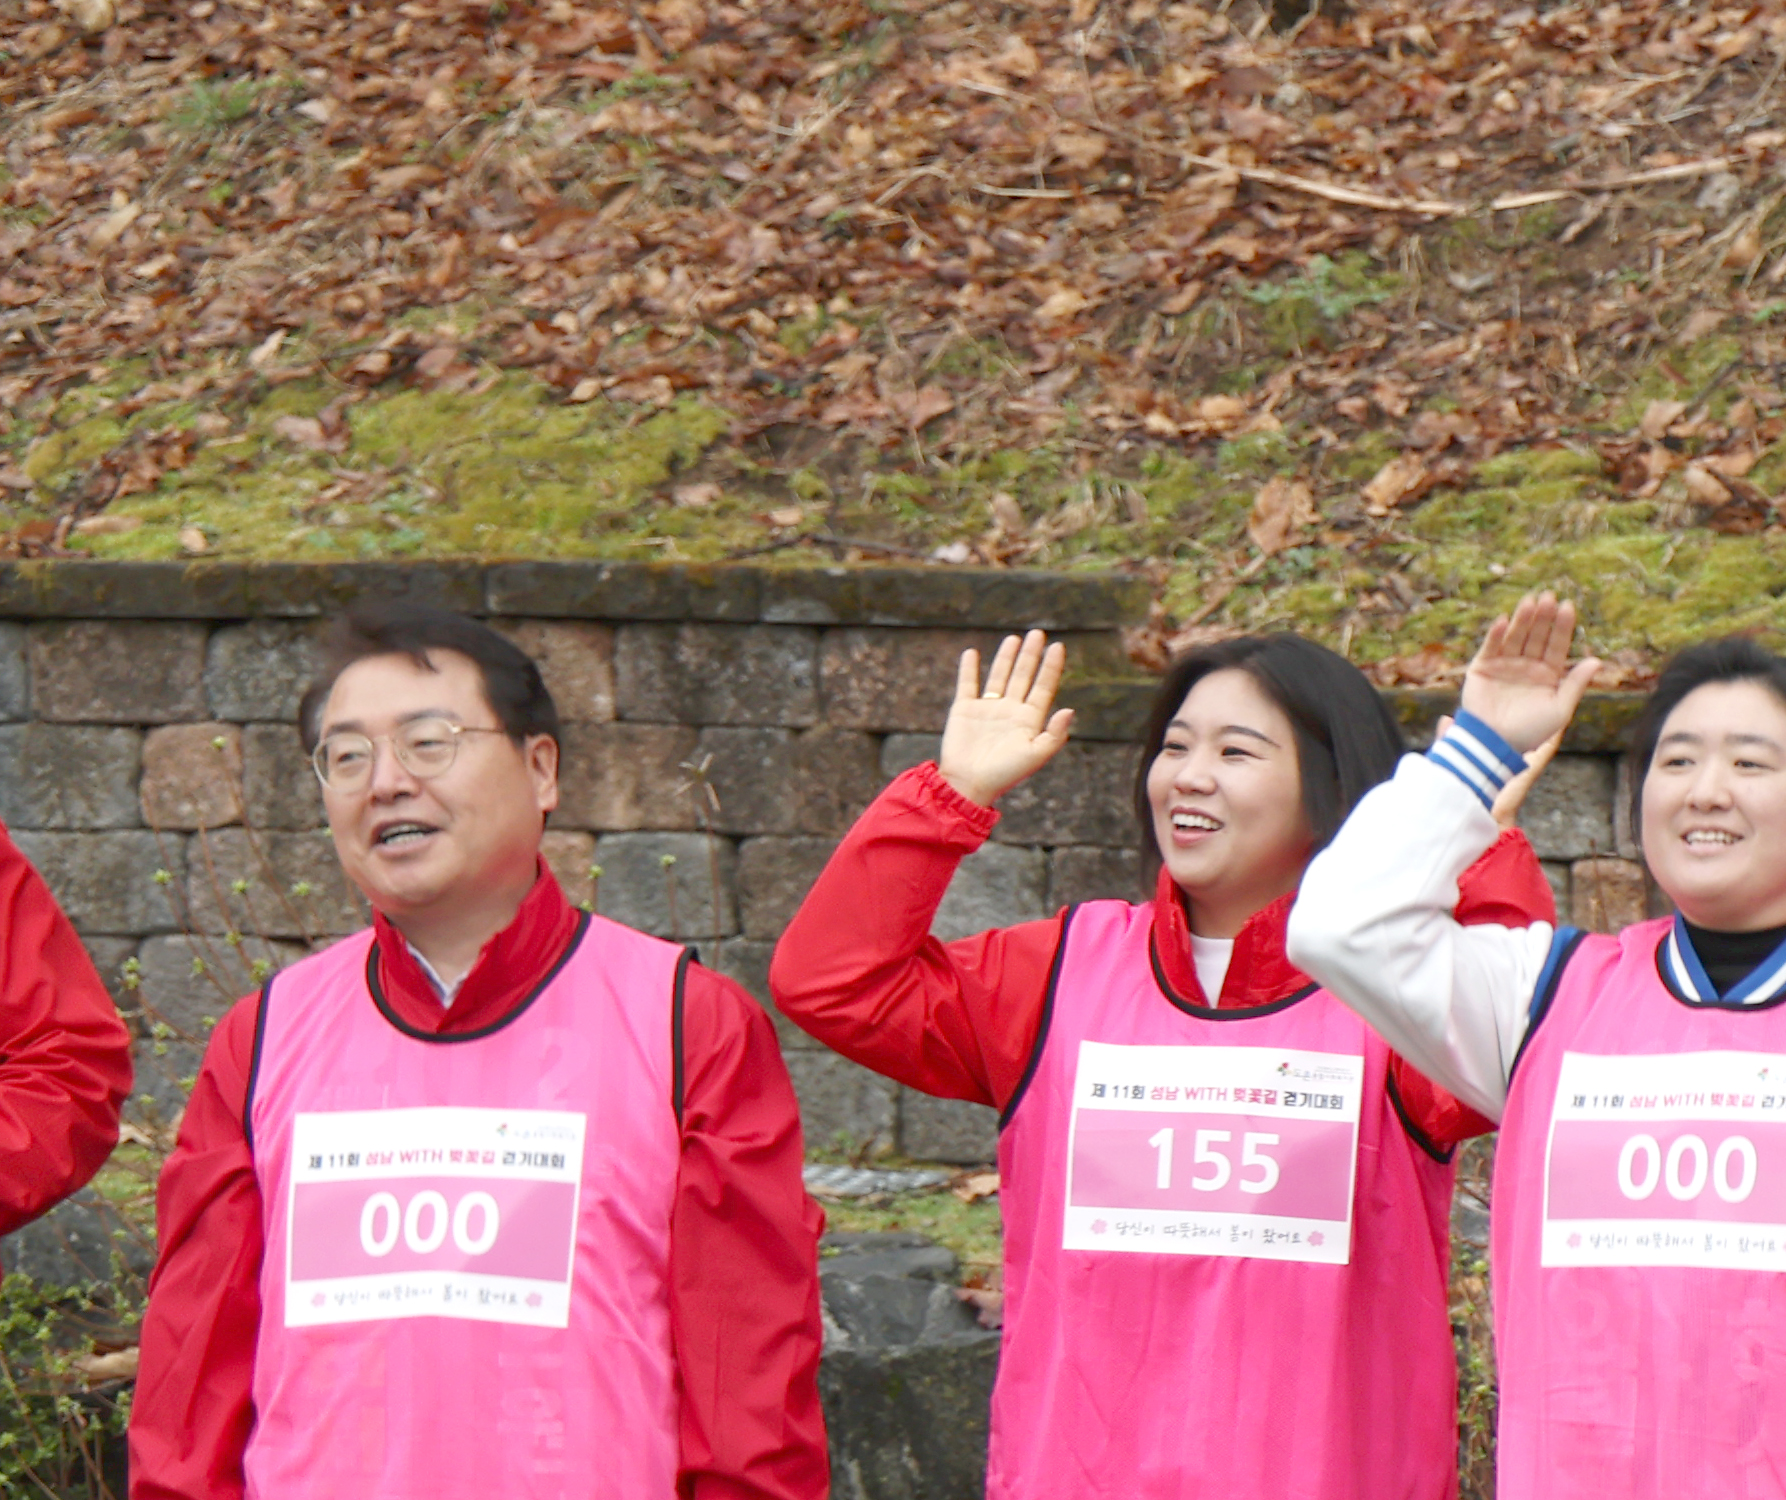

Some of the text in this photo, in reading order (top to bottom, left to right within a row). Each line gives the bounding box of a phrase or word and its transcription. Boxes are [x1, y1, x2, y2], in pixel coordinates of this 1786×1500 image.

[1092, 1083, 1343, 1109] 제 11회 성남 WITH 벚꽃길 걷기대회
[1572, 1094, 1585, 1108] 제
[1592, 1095, 1624, 1108] 11회
[1663, 1093, 1704, 1107] WITH
[400, 1150, 442, 1163] WITH
[1148, 1128, 1280, 1194] 155
[1618, 1134, 1757, 1203] 000
[360, 1190, 500, 1257] 000
[1116, 1222, 1302, 1244] 당신이 따뜻해서 봄이 왔어요
